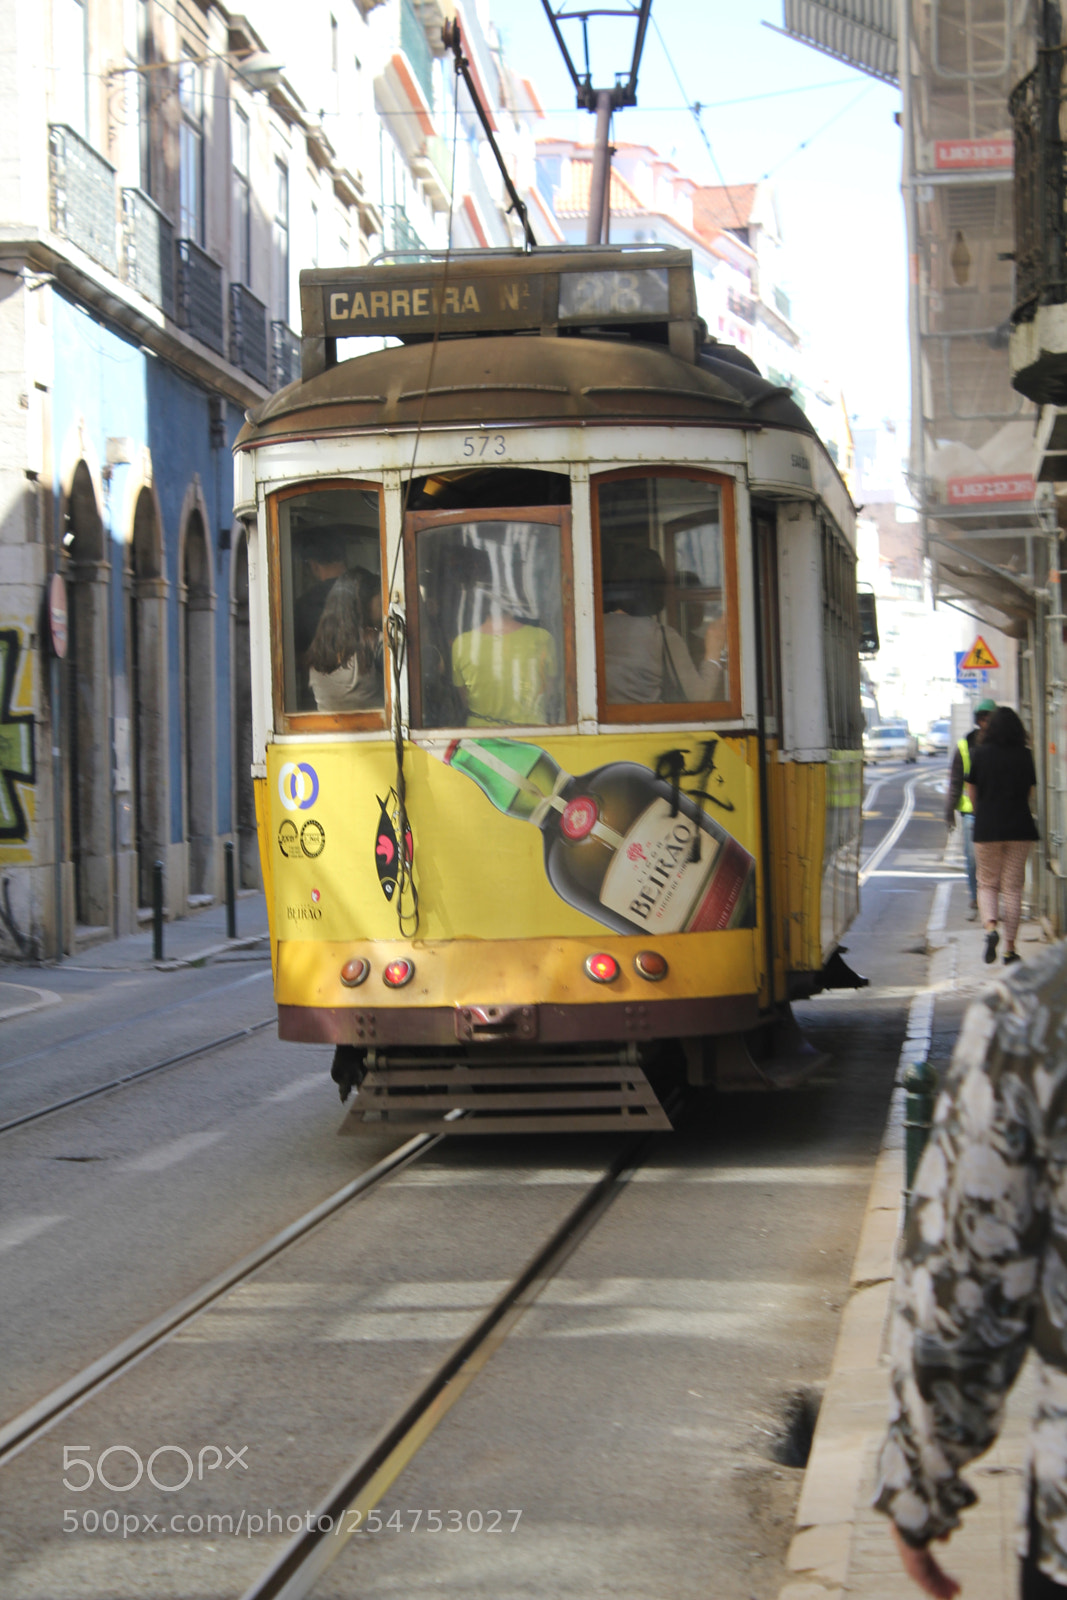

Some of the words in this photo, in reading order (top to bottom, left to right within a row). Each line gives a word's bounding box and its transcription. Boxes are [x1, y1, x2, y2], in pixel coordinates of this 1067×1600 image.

[330, 286, 480, 320] CARREIRA
[576, 272, 642, 314] 28
[463, 434, 506, 457] 573
[629, 824, 692, 920] BEIRÃO
